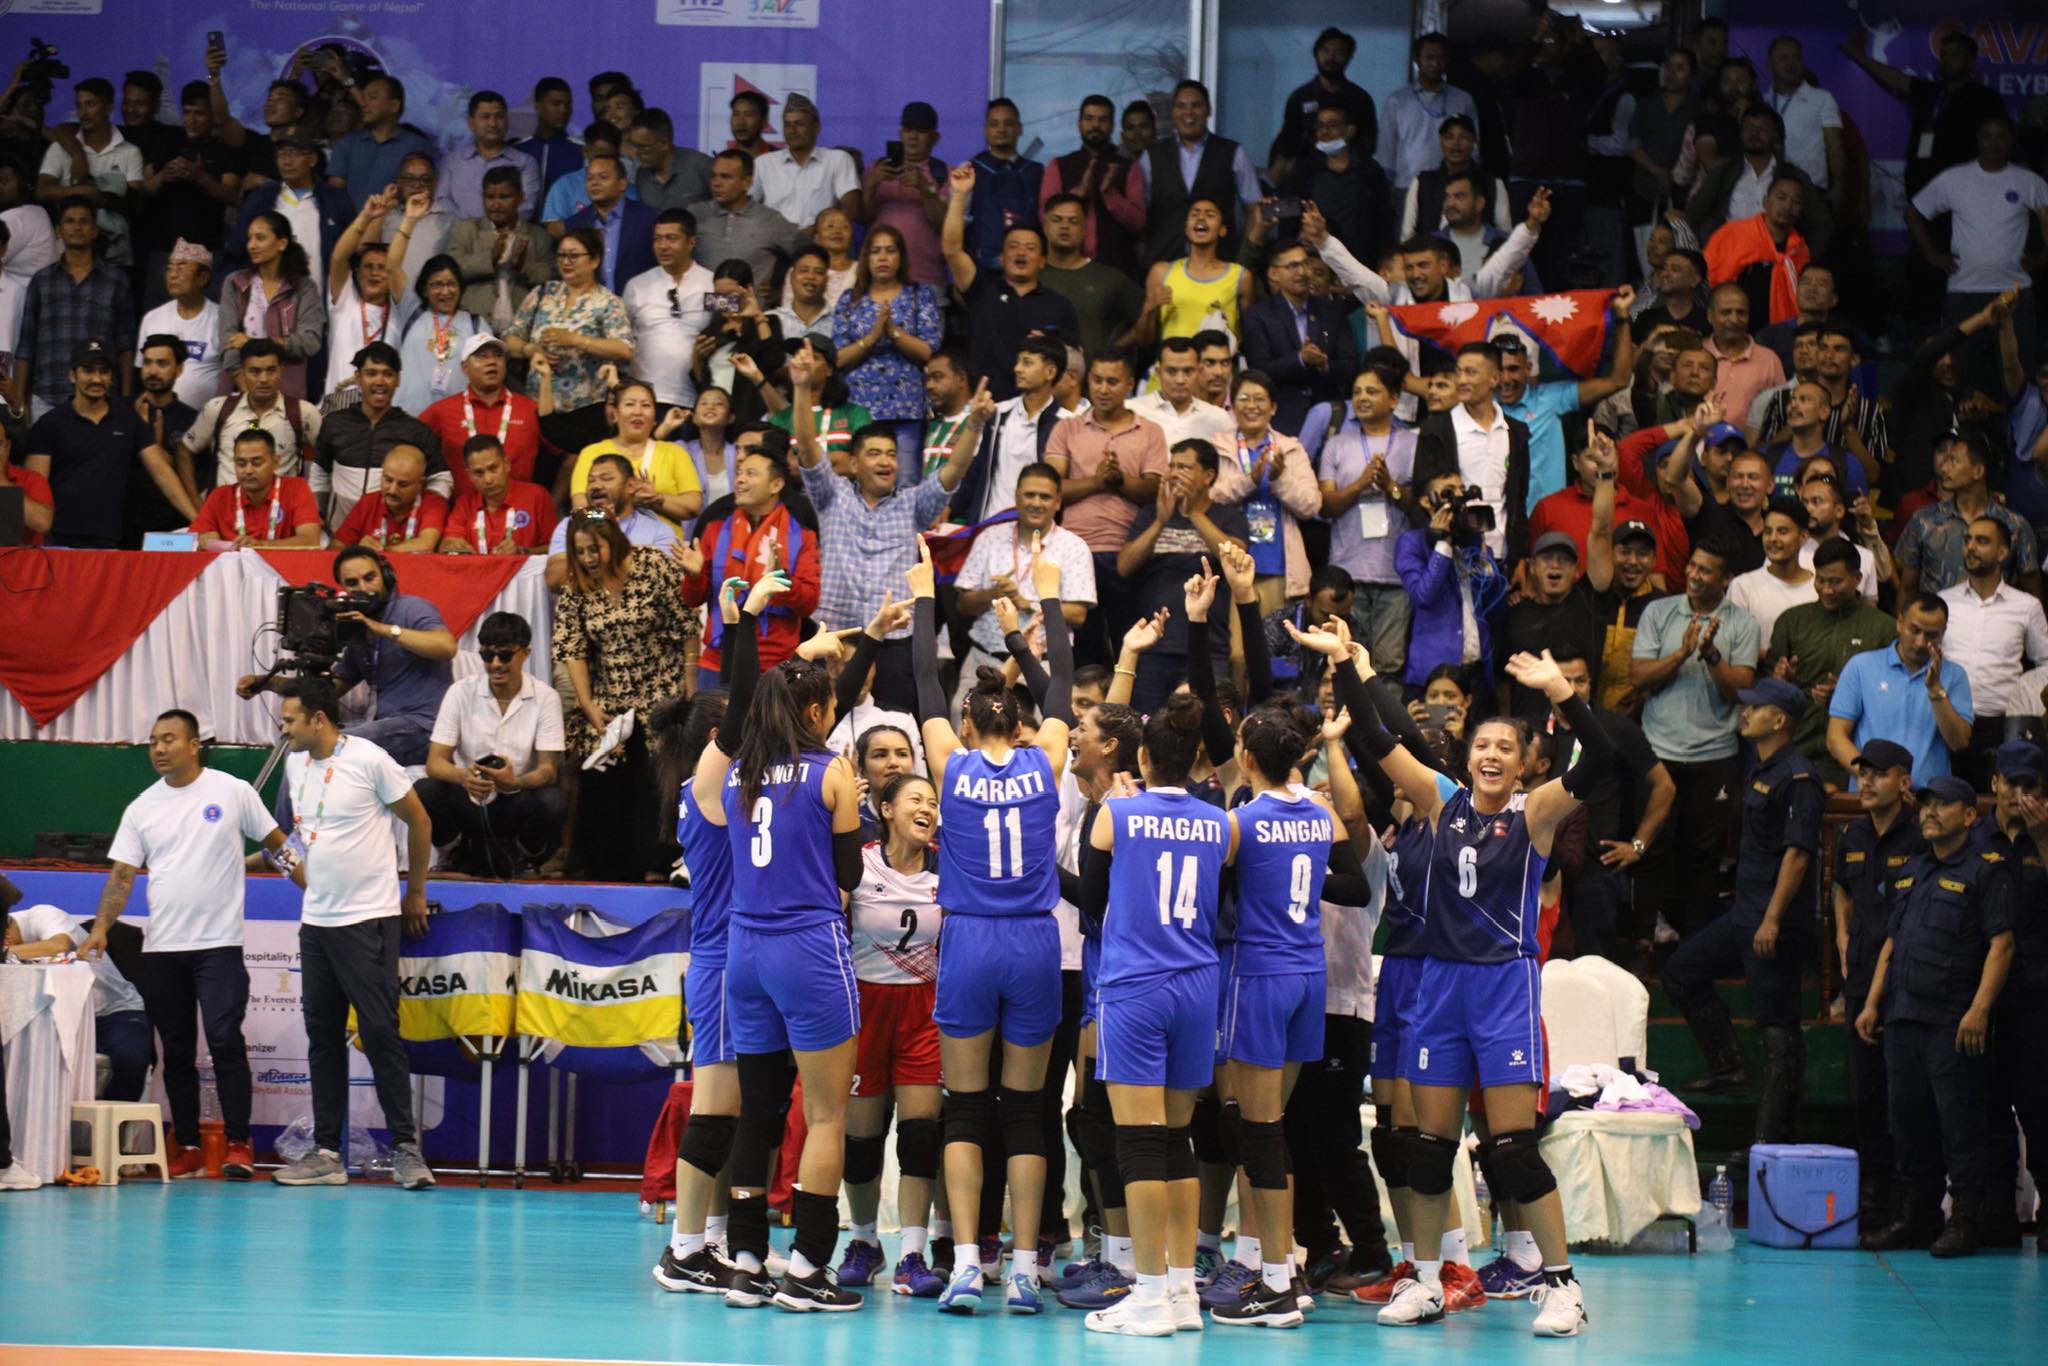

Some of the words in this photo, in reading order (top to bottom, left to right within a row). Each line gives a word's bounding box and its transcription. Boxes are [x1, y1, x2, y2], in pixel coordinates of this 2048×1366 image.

[273, 0, 326, 10] National
[328, 1, 365, 11] Game
[1929, 22, 2048, 64] CAV
[728, 763, 810, 788] SASWOTI
[953, 770, 1044, 802] AARATI
[751, 796, 773, 868] 3
[983, 807, 1023, 878] 11
[1127, 815, 1221, 844] PRAGATI
[1458, 846, 1477, 898] 6
[1156, 851, 1198, 929] 14
[1287, 853, 1312, 924] 9
[896, 909, 918, 952] 2
[244, 952, 293, 964] ospitality
[398, 972, 467, 996] KASA
[264, 995, 297, 1004] Everest
[245, 1043, 277, 1053] anizer
[1418, 1047, 1429, 1070] 6
[850, 1074, 861, 1095] 2
